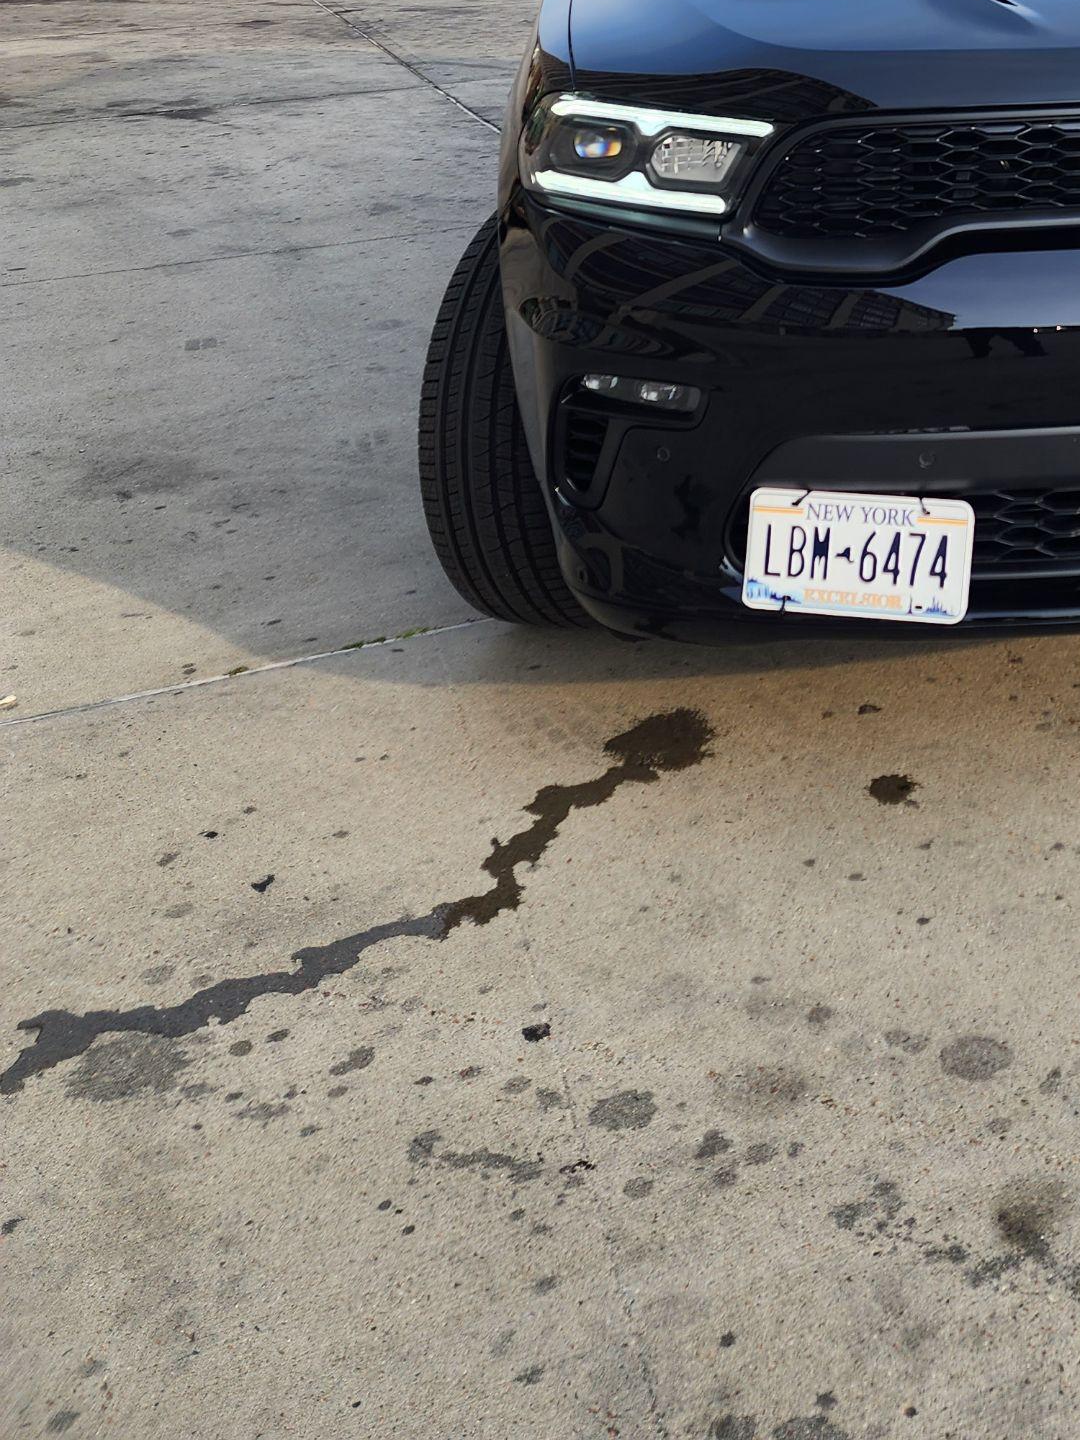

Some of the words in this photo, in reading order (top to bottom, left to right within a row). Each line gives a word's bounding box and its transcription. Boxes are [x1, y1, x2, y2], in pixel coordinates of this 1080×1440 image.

[805, 503, 854, 524] NEW
[859, 506, 915, 527] YORK
[763, 523, 831, 581] LBM
[858, 530, 949, 589] 6474
[803, 588, 902, 609] EXCELSIOR
